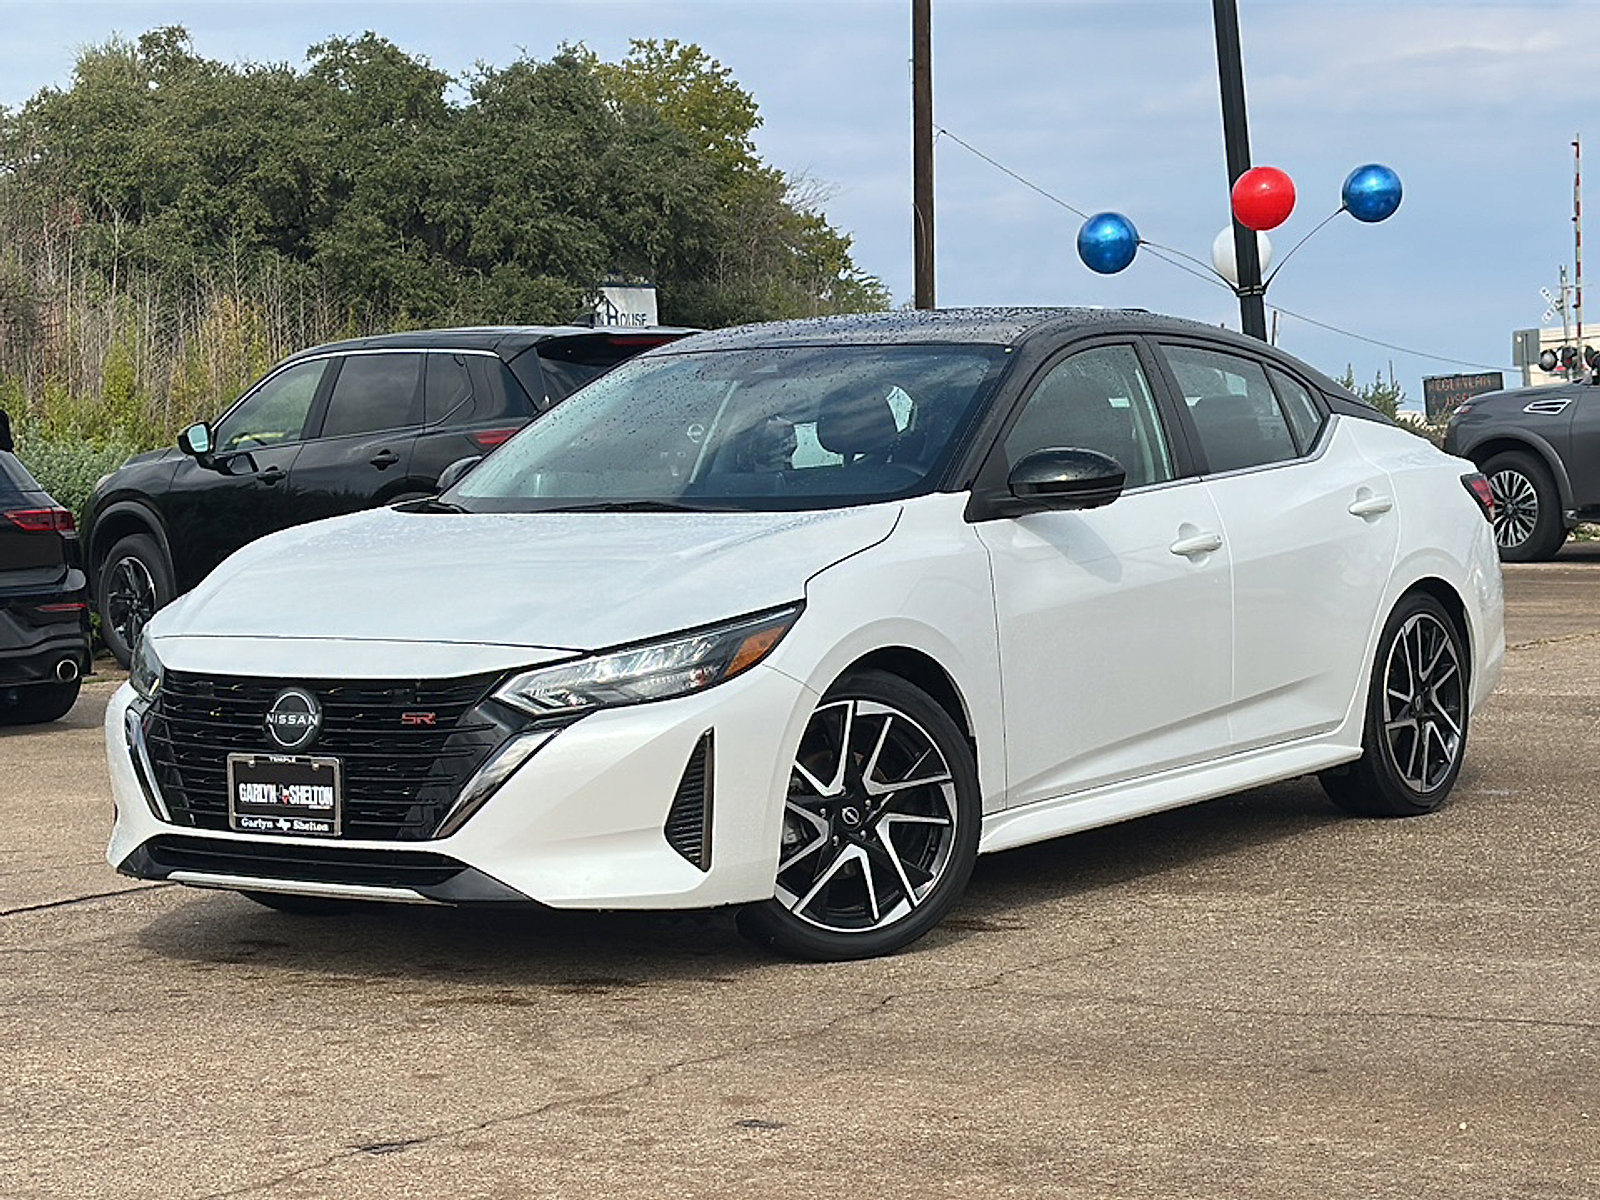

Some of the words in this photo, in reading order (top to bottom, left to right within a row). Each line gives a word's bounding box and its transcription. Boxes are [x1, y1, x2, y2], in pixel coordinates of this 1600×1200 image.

[265, 713, 319, 726] NISSAN
[401, 711, 436, 725] SR
[239, 783, 277, 803] GARLYN
[289, 785, 334, 806] SHELTON
[241, 817, 274, 830] Garlyn
[293, 820, 329, 832] Shelton
